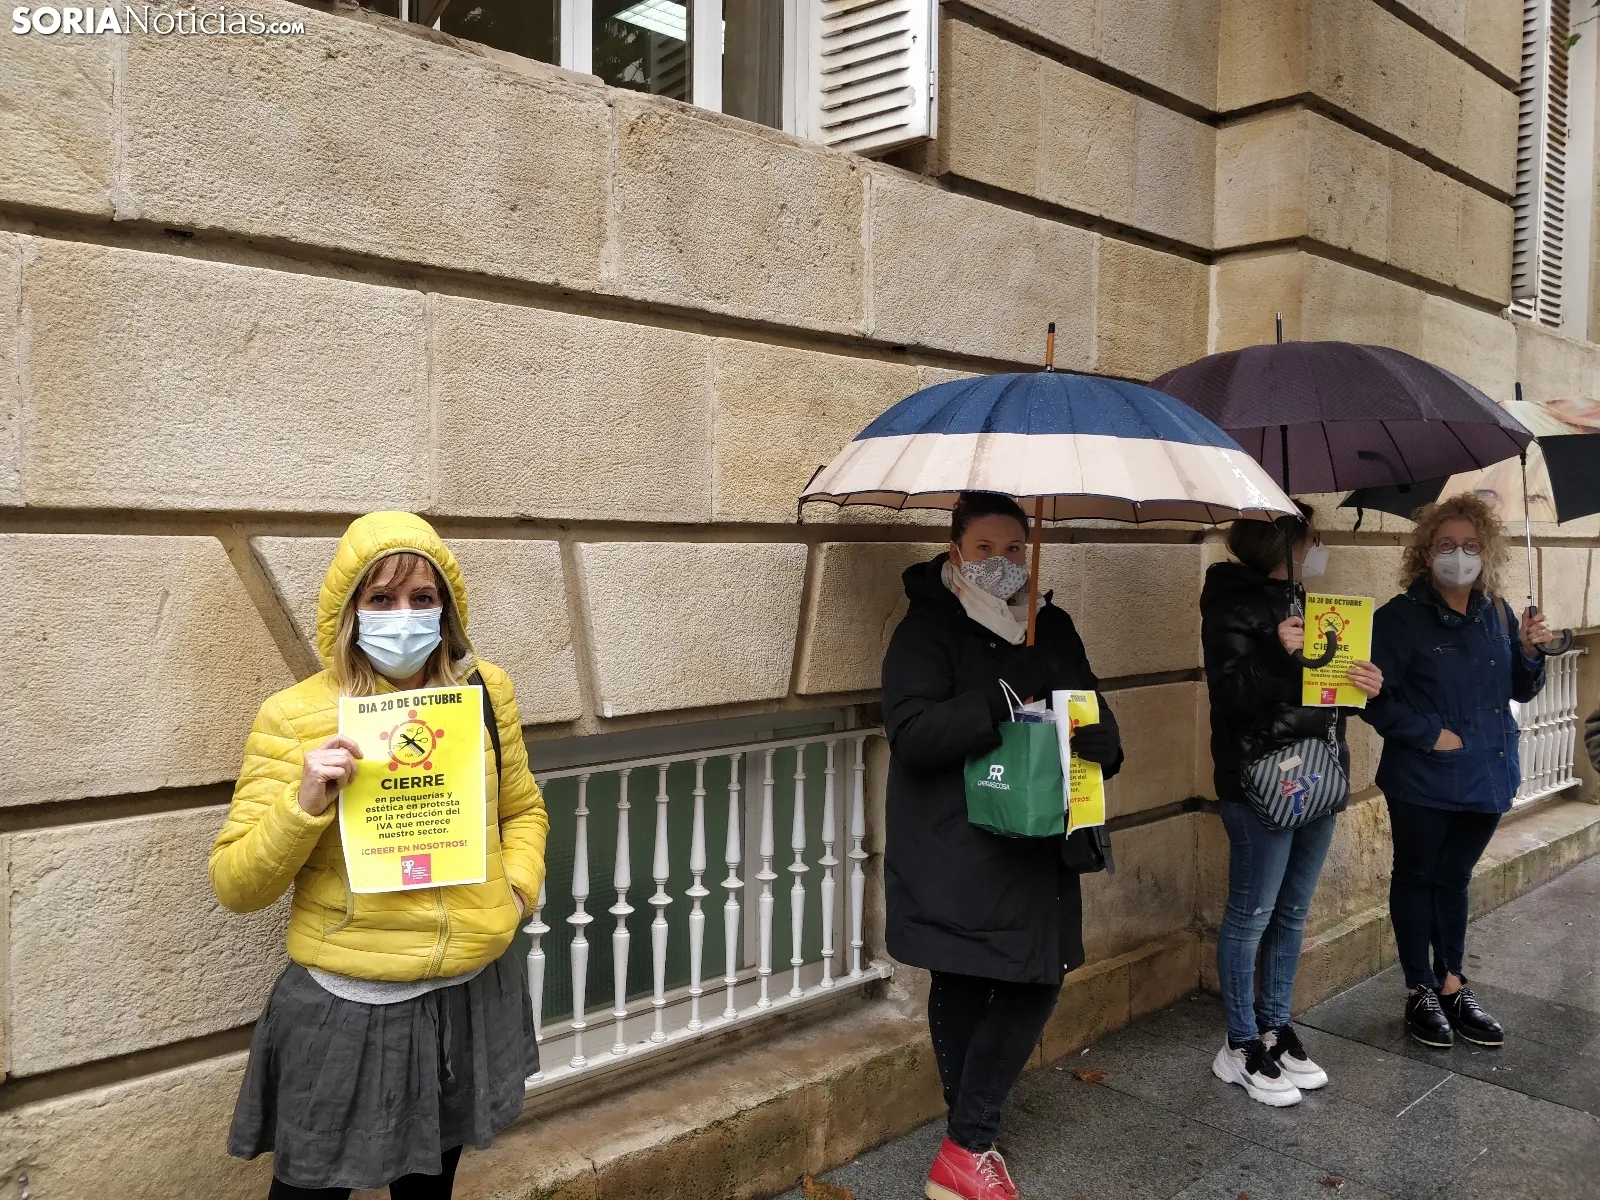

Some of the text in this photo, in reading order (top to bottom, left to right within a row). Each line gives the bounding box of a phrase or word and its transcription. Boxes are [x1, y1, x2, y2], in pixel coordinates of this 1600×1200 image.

[1334, 598, 1362, 607] OCTUBRE
[358, 692, 463, 714] DIA 20 DE OCTUBRE
[380, 773, 445, 790] CIERRE
[389, 791, 445, 804] peluquerías
[447, 791, 453, 799] y
[365, 803, 404, 813] estética
[420, 799, 460, 810] protesta
[366, 807, 460, 824] por la reducción del
[376, 818, 451, 831] IVA que merece
[378, 826, 449, 840] nuestro sector.
[397, 844, 410, 853] EN
[412, 839, 468, 852] NOSOTROS!
